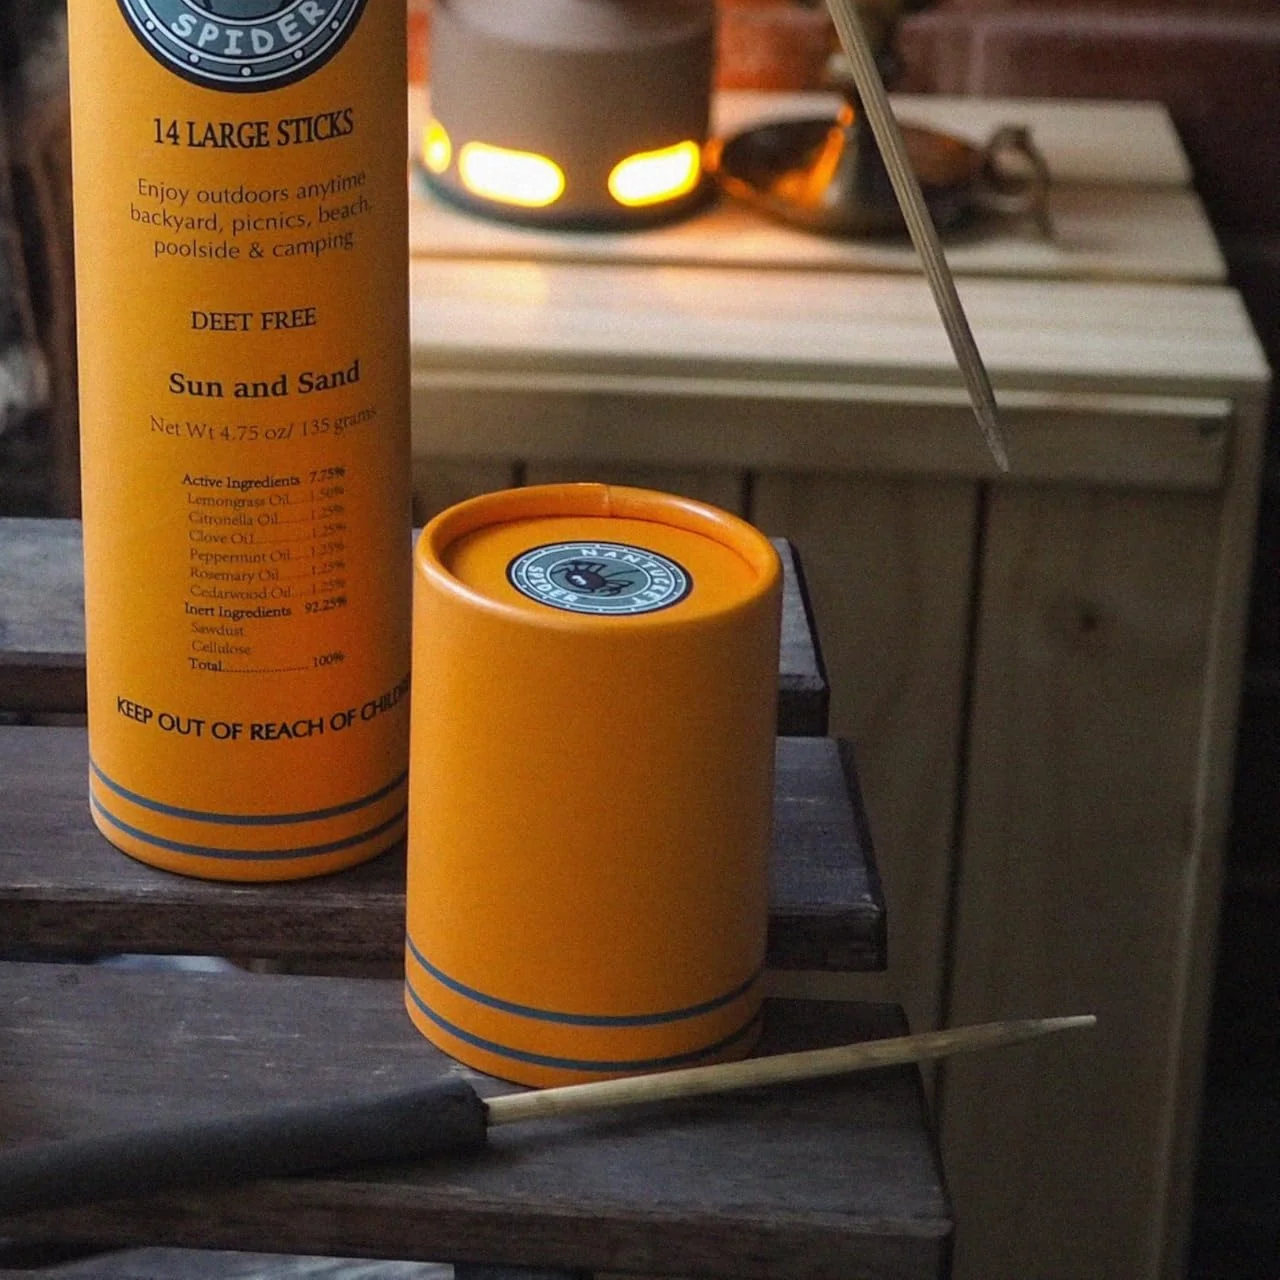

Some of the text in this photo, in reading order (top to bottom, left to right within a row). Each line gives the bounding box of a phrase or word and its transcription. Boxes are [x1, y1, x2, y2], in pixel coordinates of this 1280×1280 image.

[170, 0, 326, 56] SPIDER
[153, 108, 355, 148] 14 LARGE STICKS
[137, 170, 367, 206] Enjoy outdoors anytime
[130, 203, 225, 234] backyard,
[232, 214, 312, 236] picnics,
[154, 231, 354, 260] poolside & camping
[191, 307, 317, 331] DEET FREE
[169, 359, 361, 398] Sun and Sand
[150, 414, 181, 437] Net
[185, 421, 215, 440] Wt
[220, 424, 259, 441] 4.75
[301, 417, 330, 437] 135
[333, 403, 378, 435] grams
[181, 473, 223, 488] Active
[227, 476, 301, 492] Ingredients
[187, 492, 266, 510] Lemongrass
[188, 511, 254, 526] Citronella
[189, 529, 227, 543] Clove
[190, 547, 266, 565] Peppermint
[190, 566, 255, 584] Rosemary
[528, 566, 579, 603] SPIDER
[581, 548, 671, 606] NANTUCKET
[190, 584, 267, 600] Cedarwood
[185, 601, 214, 618] Inert
[218, 605, 292, 621] Ingredients
[191, 622, 244, 637] Sawdust
[191, 640, 252, 656] Cellulose
[313, 650, 345, 669] 100%
[117, 696, 153, 724] KEEP
[158, 712, 205, 737] OUT
[212, 722, 244, 740] OF
[250, 718, 323, 741] REACH
[330, 708, 357, 732] OF
